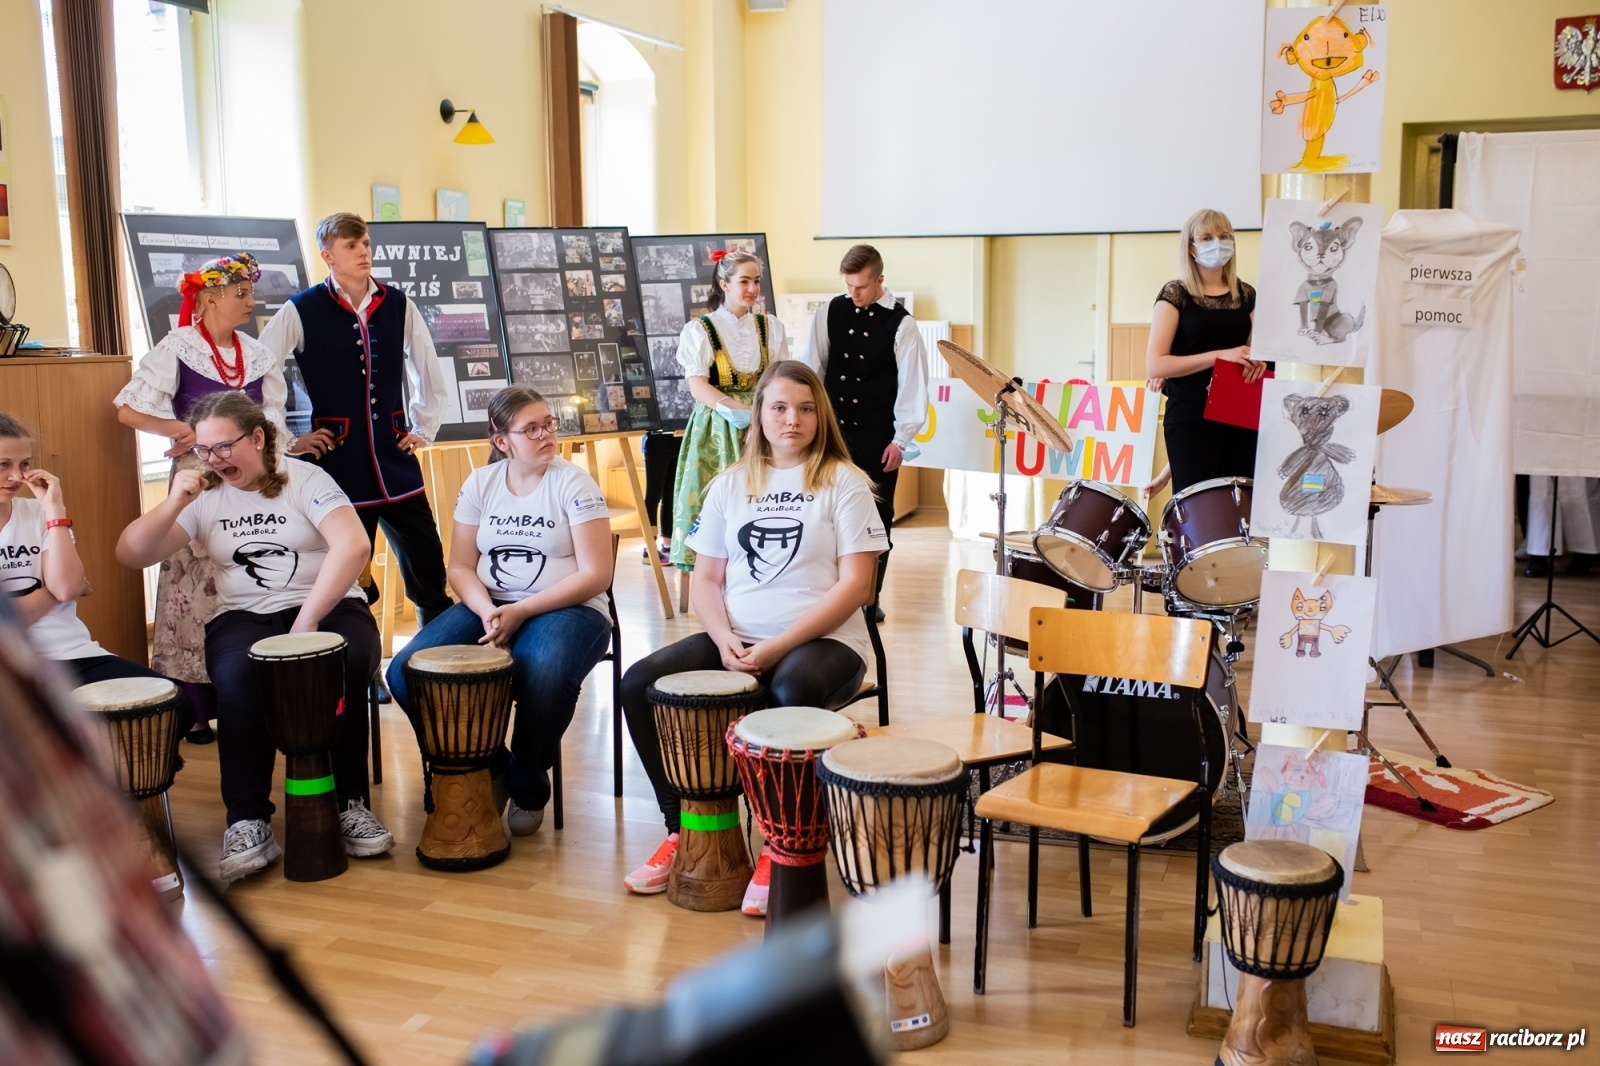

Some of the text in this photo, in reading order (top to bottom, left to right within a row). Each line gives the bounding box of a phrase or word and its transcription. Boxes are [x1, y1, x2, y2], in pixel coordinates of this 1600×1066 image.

[409, 262, 417, 277] I
[1410, 264, 1472, 281] pierwsza
[1415, 310, 1462, 324] pomoc
[985, 430, 1134, 484] TUWIM
[745, 491, 815, 504] TUMBAO
[220, 513, 287, 531] TUMBAO
[489, 515, 556, 529] TUMBAO
